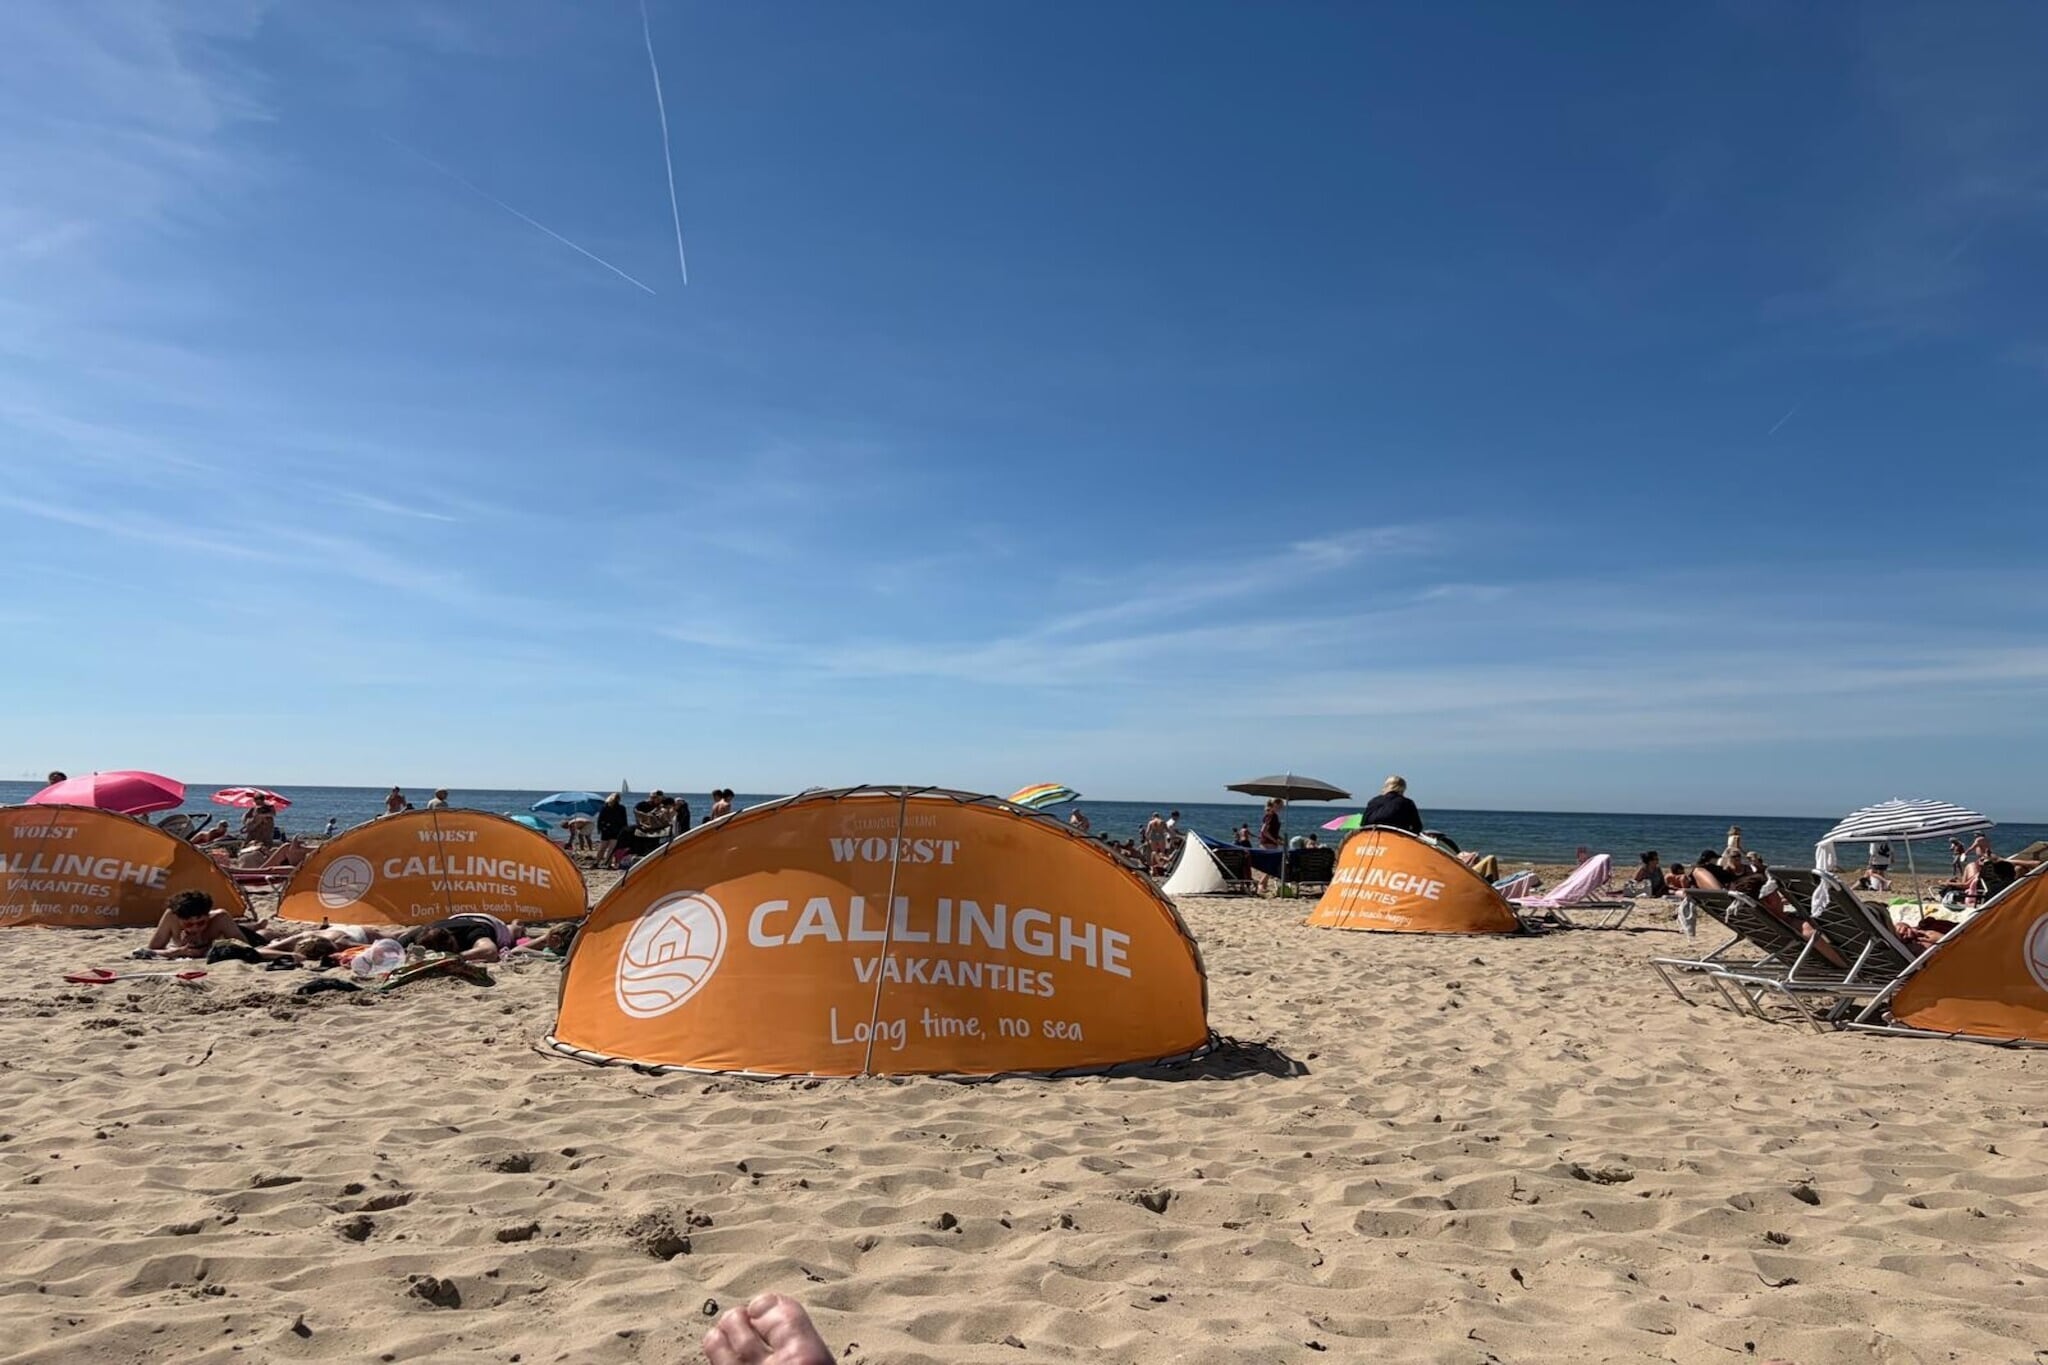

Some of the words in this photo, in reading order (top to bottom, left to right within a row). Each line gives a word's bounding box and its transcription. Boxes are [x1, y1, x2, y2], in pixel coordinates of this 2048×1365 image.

[418, 830, 478, 843] WOEST
[829, 838, 960, 864] WOEST
[383, 855, 551, 889] CALLINGHE
[7, 879, 112, 898] VAKANTIES
[432, 880, 518, 896] VAKANTIES
[70, 903, 88, 914] no
[411, 903, 440, 917] Don't
[482, 899, 511, 912] beach
[515, 900, 543, 917] happy
[747, 896, 1132, 978] CALLINGHE
[852, 956, 1056, 998] VAKANTIES
[829, 1007, 907, 1051] Long
[920, 1007, 986, 1040] time,
[999, 1017, 1029, 1038] no
[1042, 1019, 1084, 1042] sea
